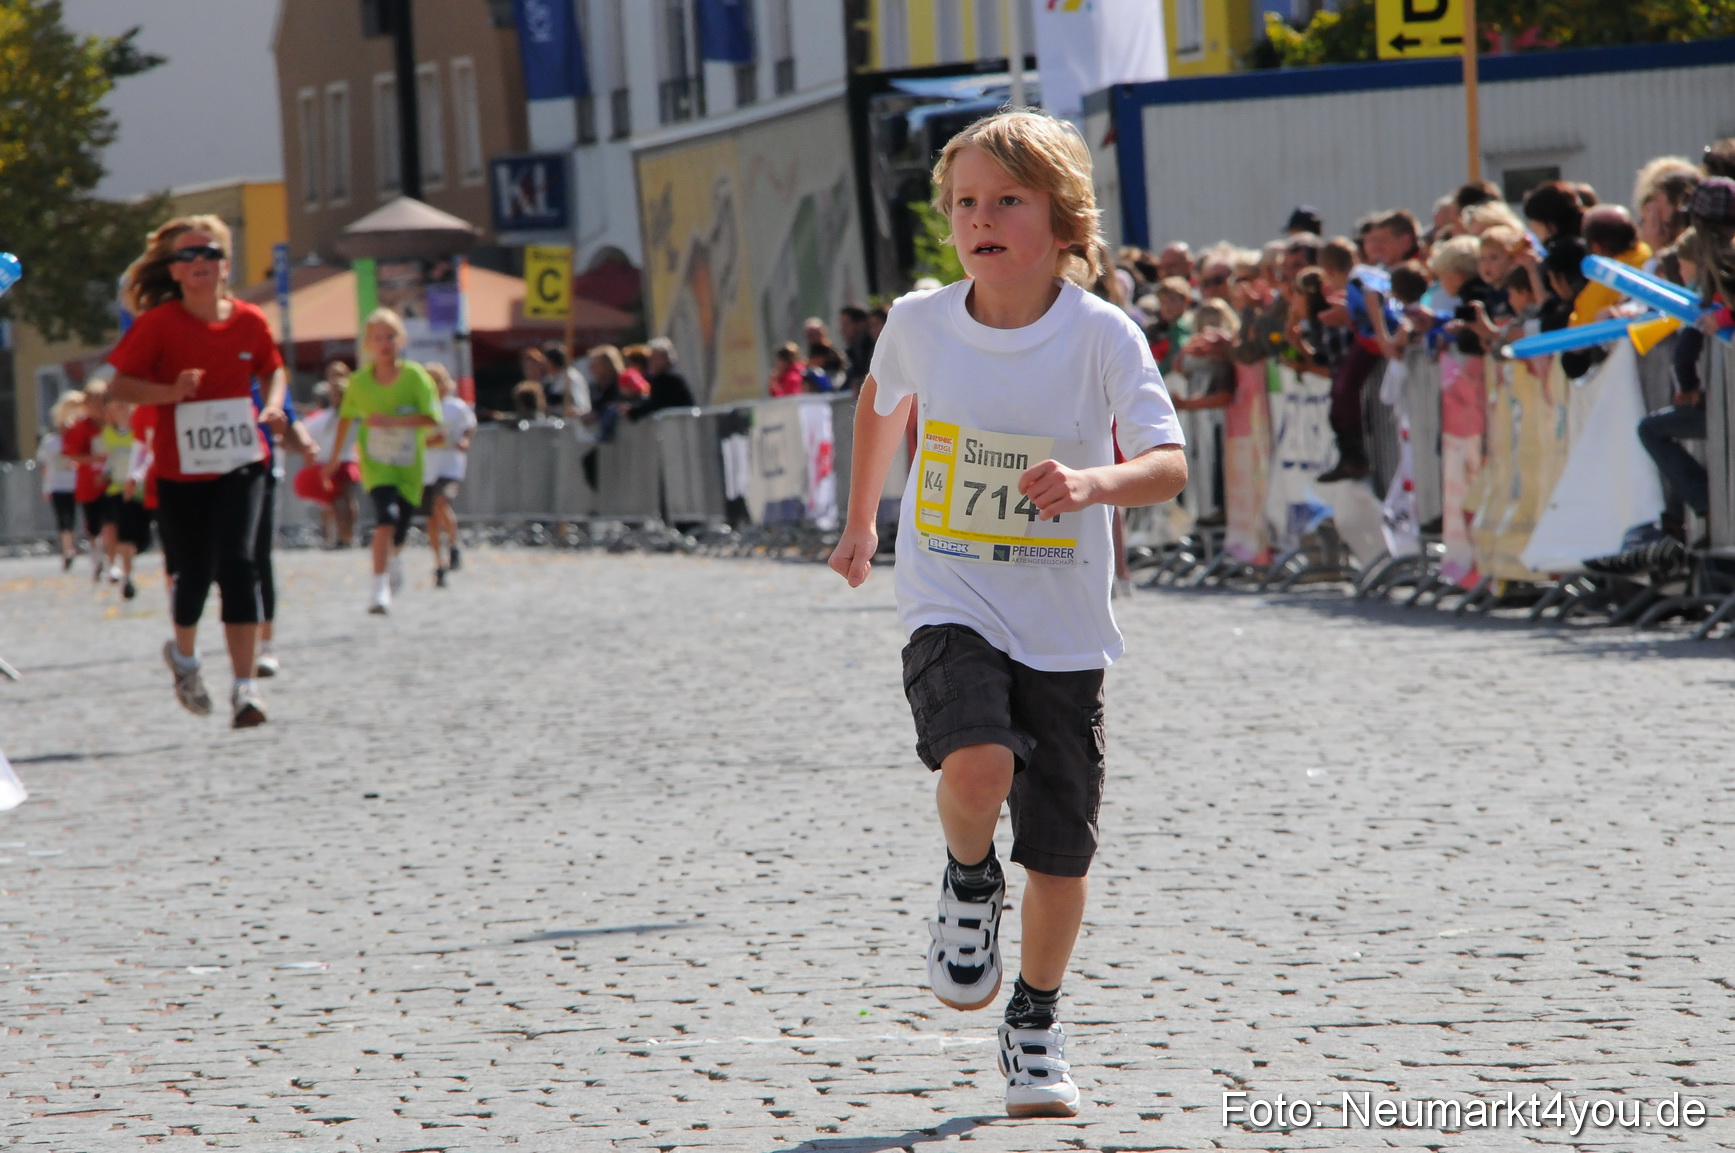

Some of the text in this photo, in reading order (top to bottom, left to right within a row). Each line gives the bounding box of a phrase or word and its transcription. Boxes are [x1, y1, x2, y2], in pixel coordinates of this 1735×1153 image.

[537, 268, 561, 304] C
[185, 422, 253, 451] 10210
[964, 437, 1029, 470] Simon
[924, 470, 943, 492] K4
[963, 480, 1060, 523] 714
[928, 537, 969, 553] BOCK
[1012, 545, 1075, 559] PFLEIDERER
